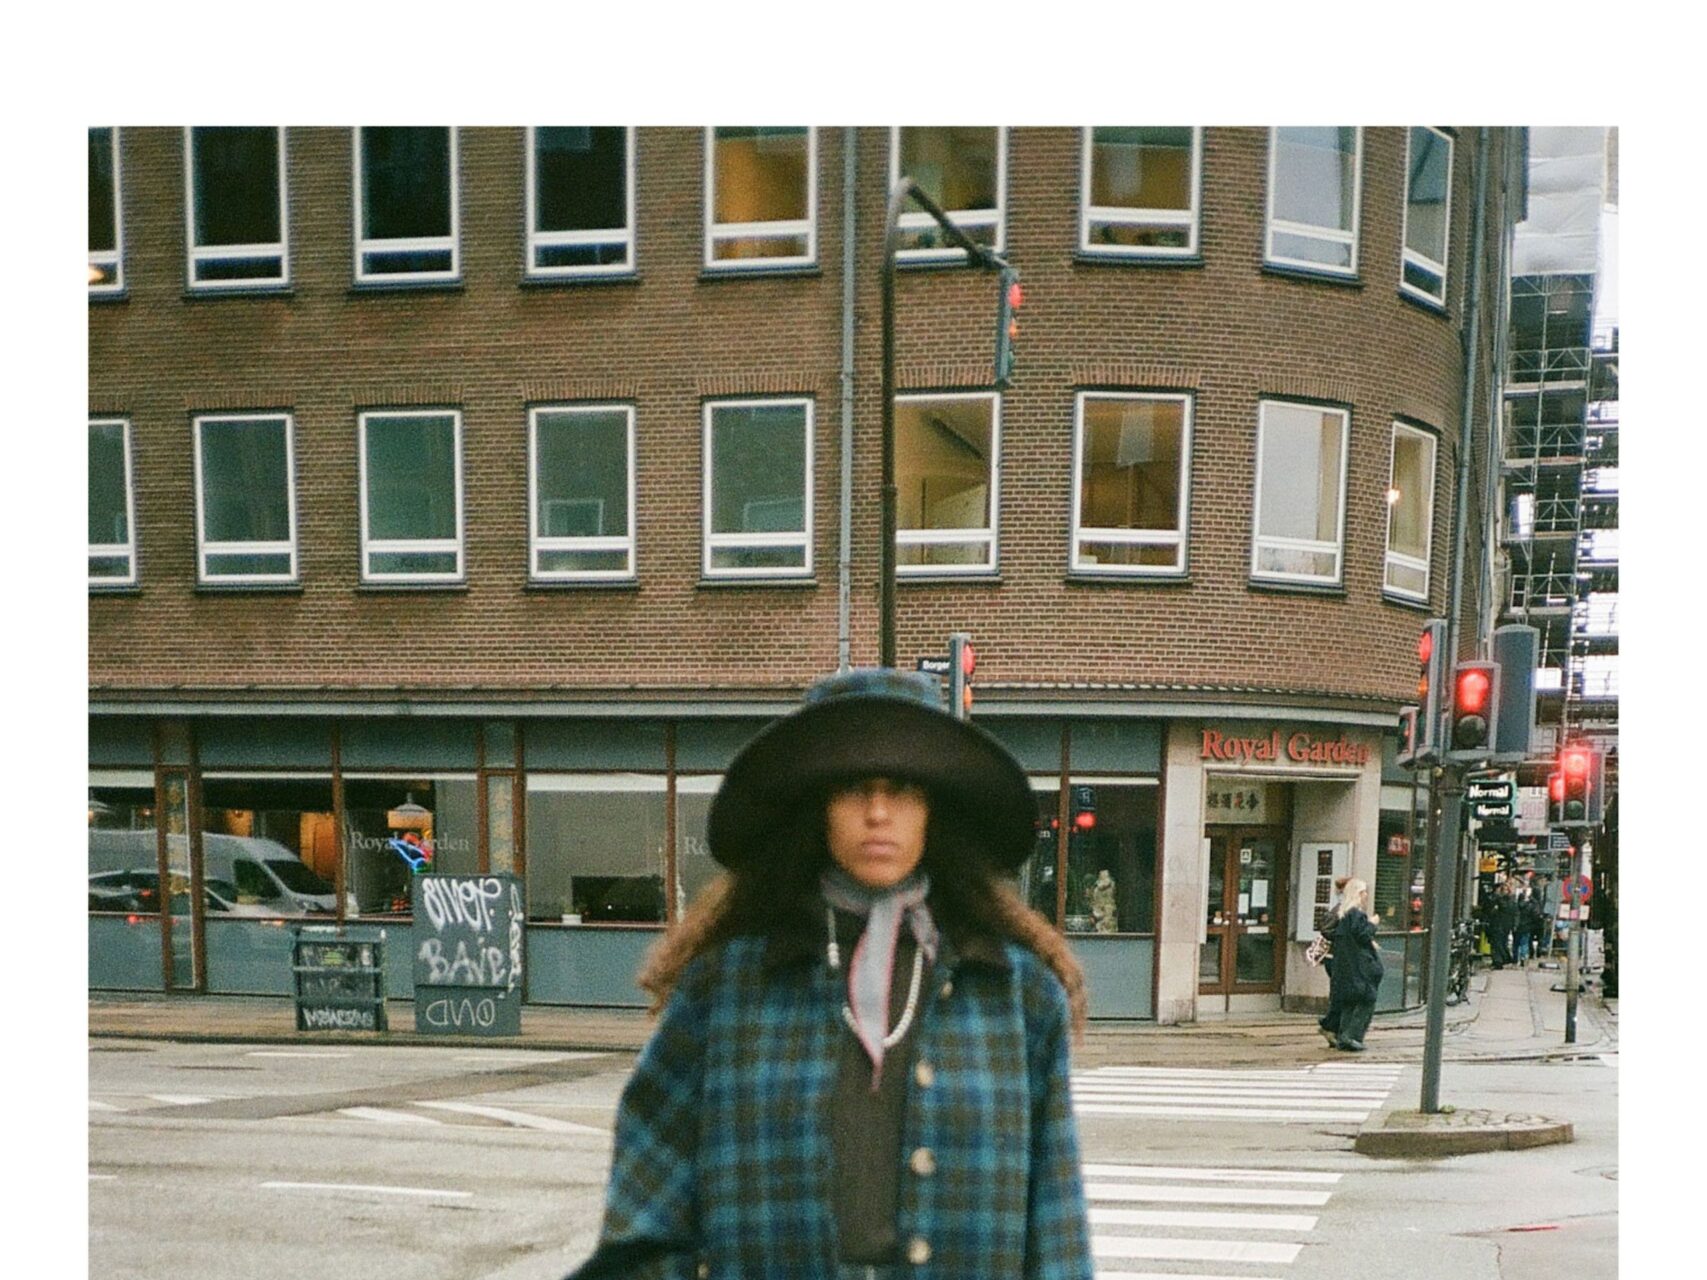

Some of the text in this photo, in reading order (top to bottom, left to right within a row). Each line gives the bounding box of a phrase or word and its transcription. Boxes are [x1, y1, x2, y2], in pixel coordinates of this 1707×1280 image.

[923, 660, 950, 671] Borger
[1201, 728, 1372, 765] Royal Garden
[1469, 785, 1509, 798] Normal
[1477, 805, 1510, 816] Normal
